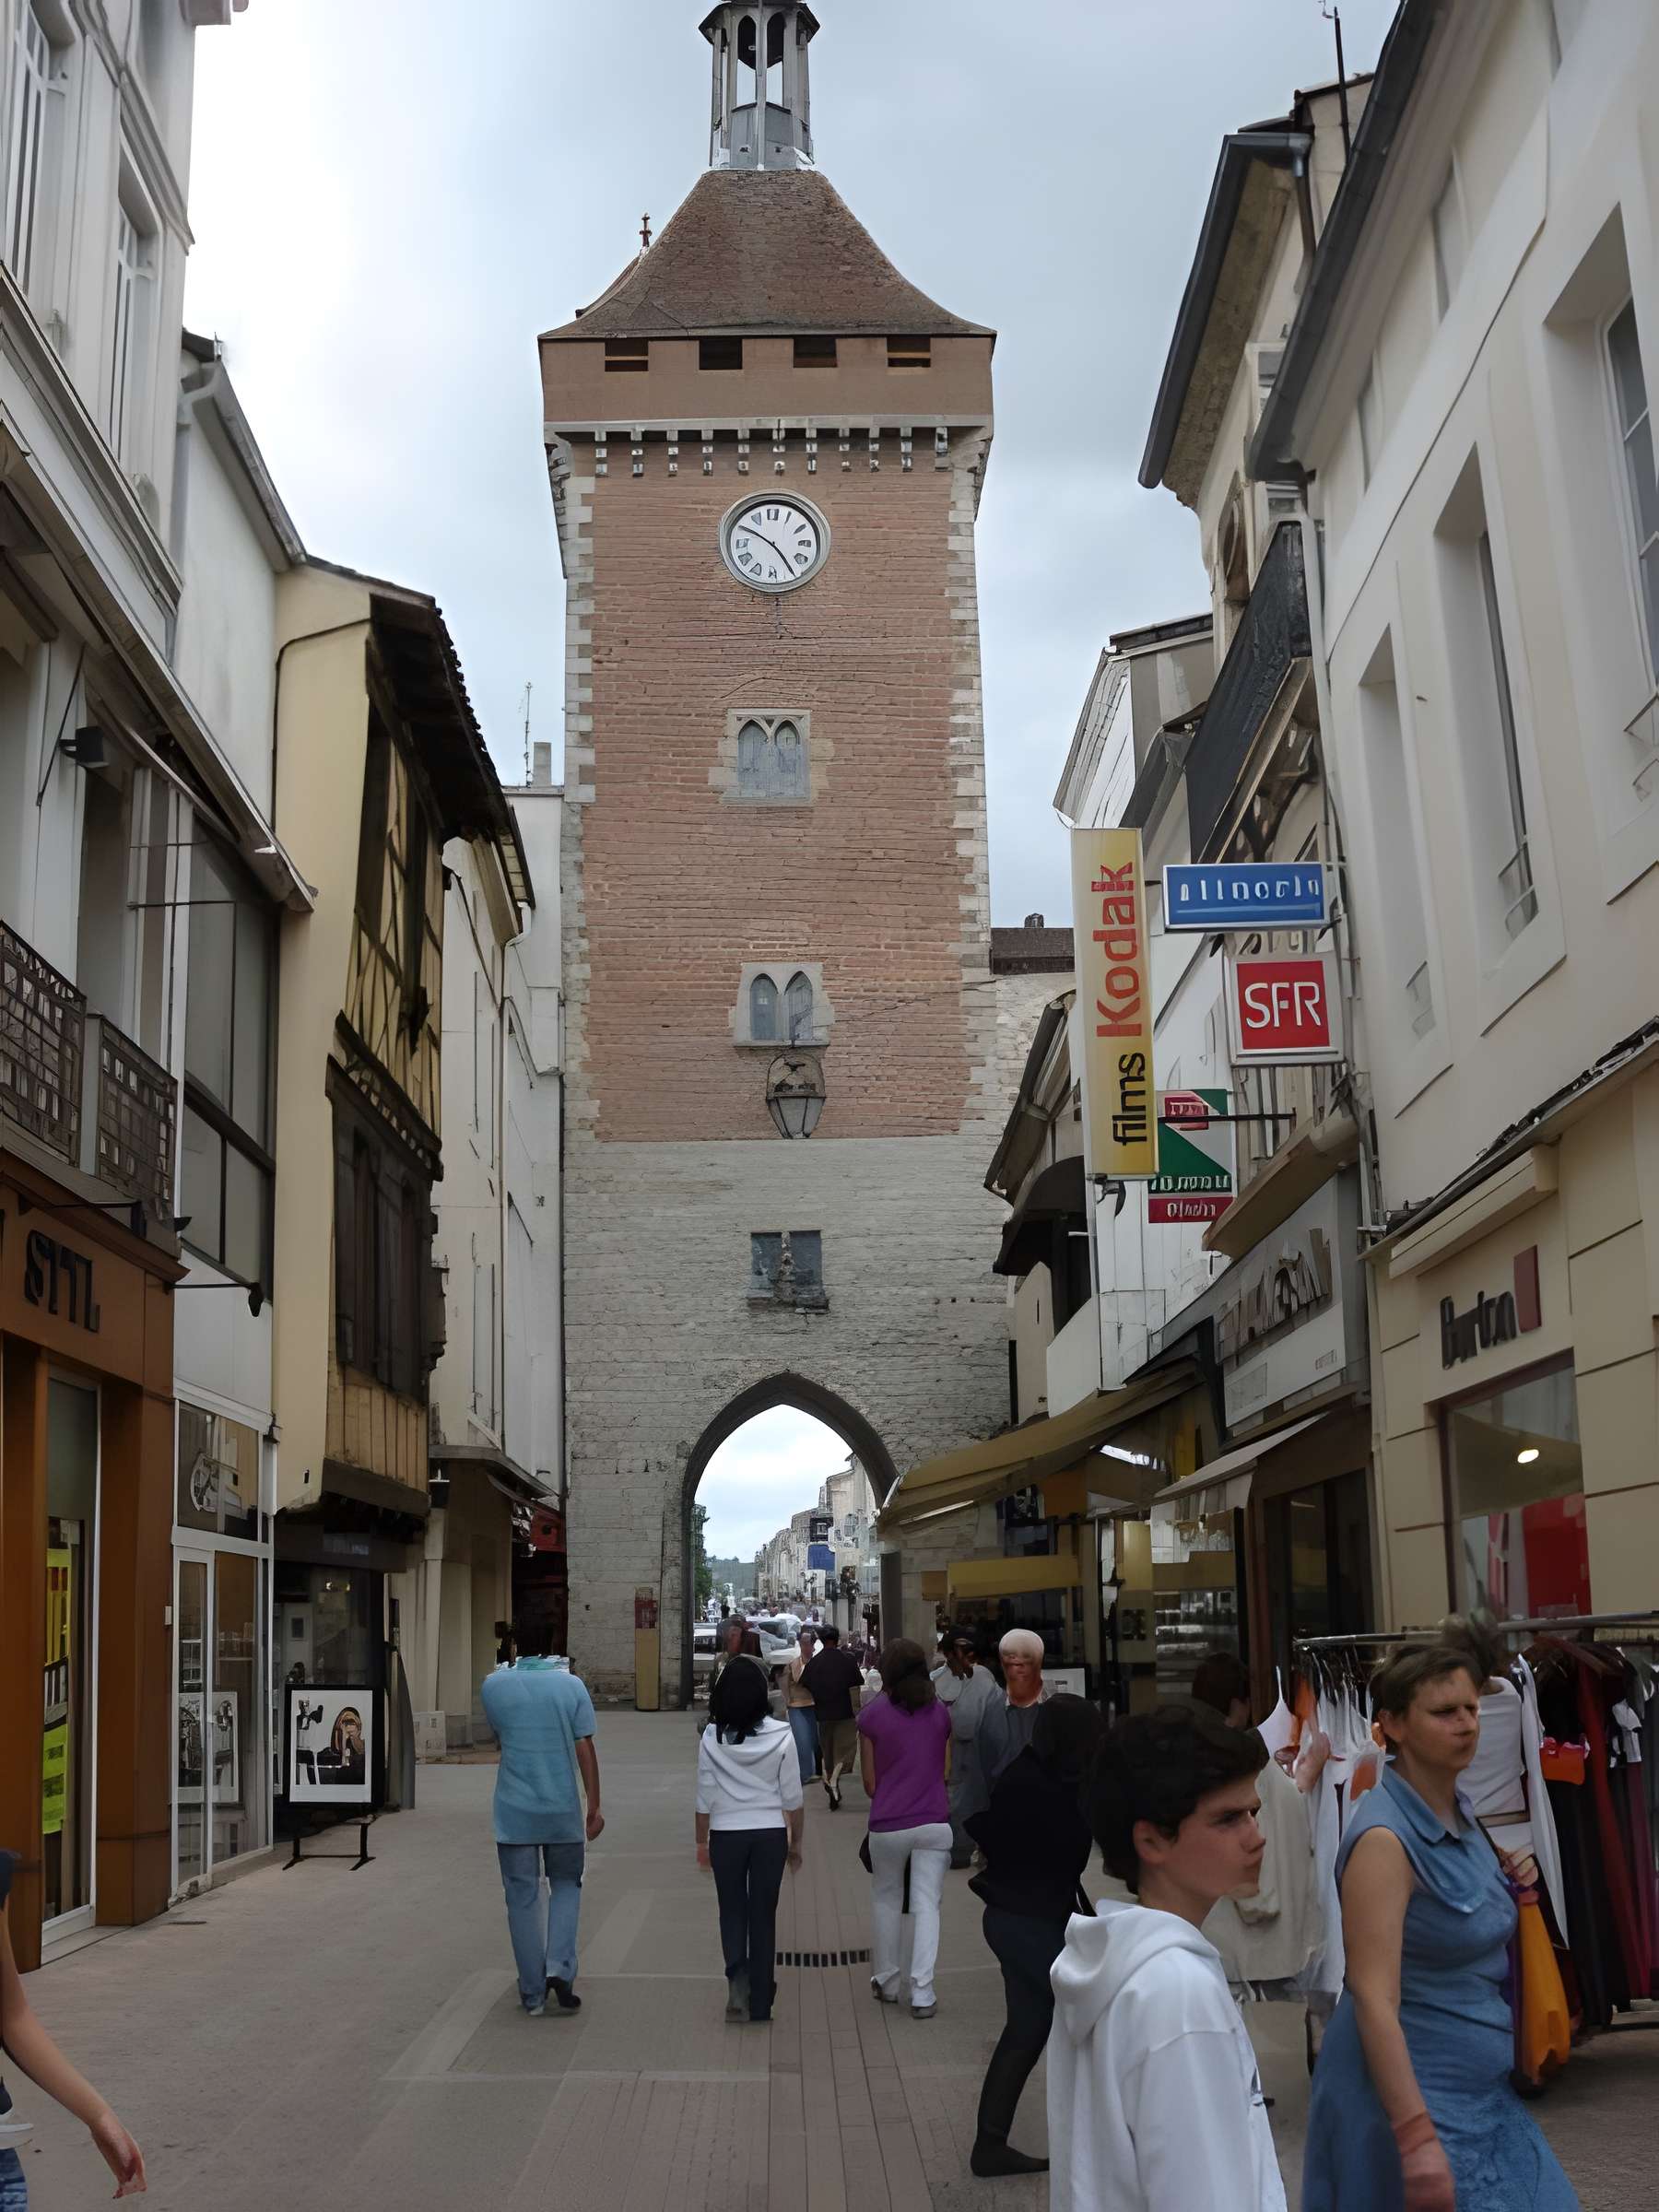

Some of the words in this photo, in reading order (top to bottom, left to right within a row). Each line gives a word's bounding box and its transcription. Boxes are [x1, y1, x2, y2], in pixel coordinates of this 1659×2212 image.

[1090, 861, 1143, 1038] Kodak
[1244, 981, 1322, 1029] SFR
[1112, 1052, 1147, 1147] films
